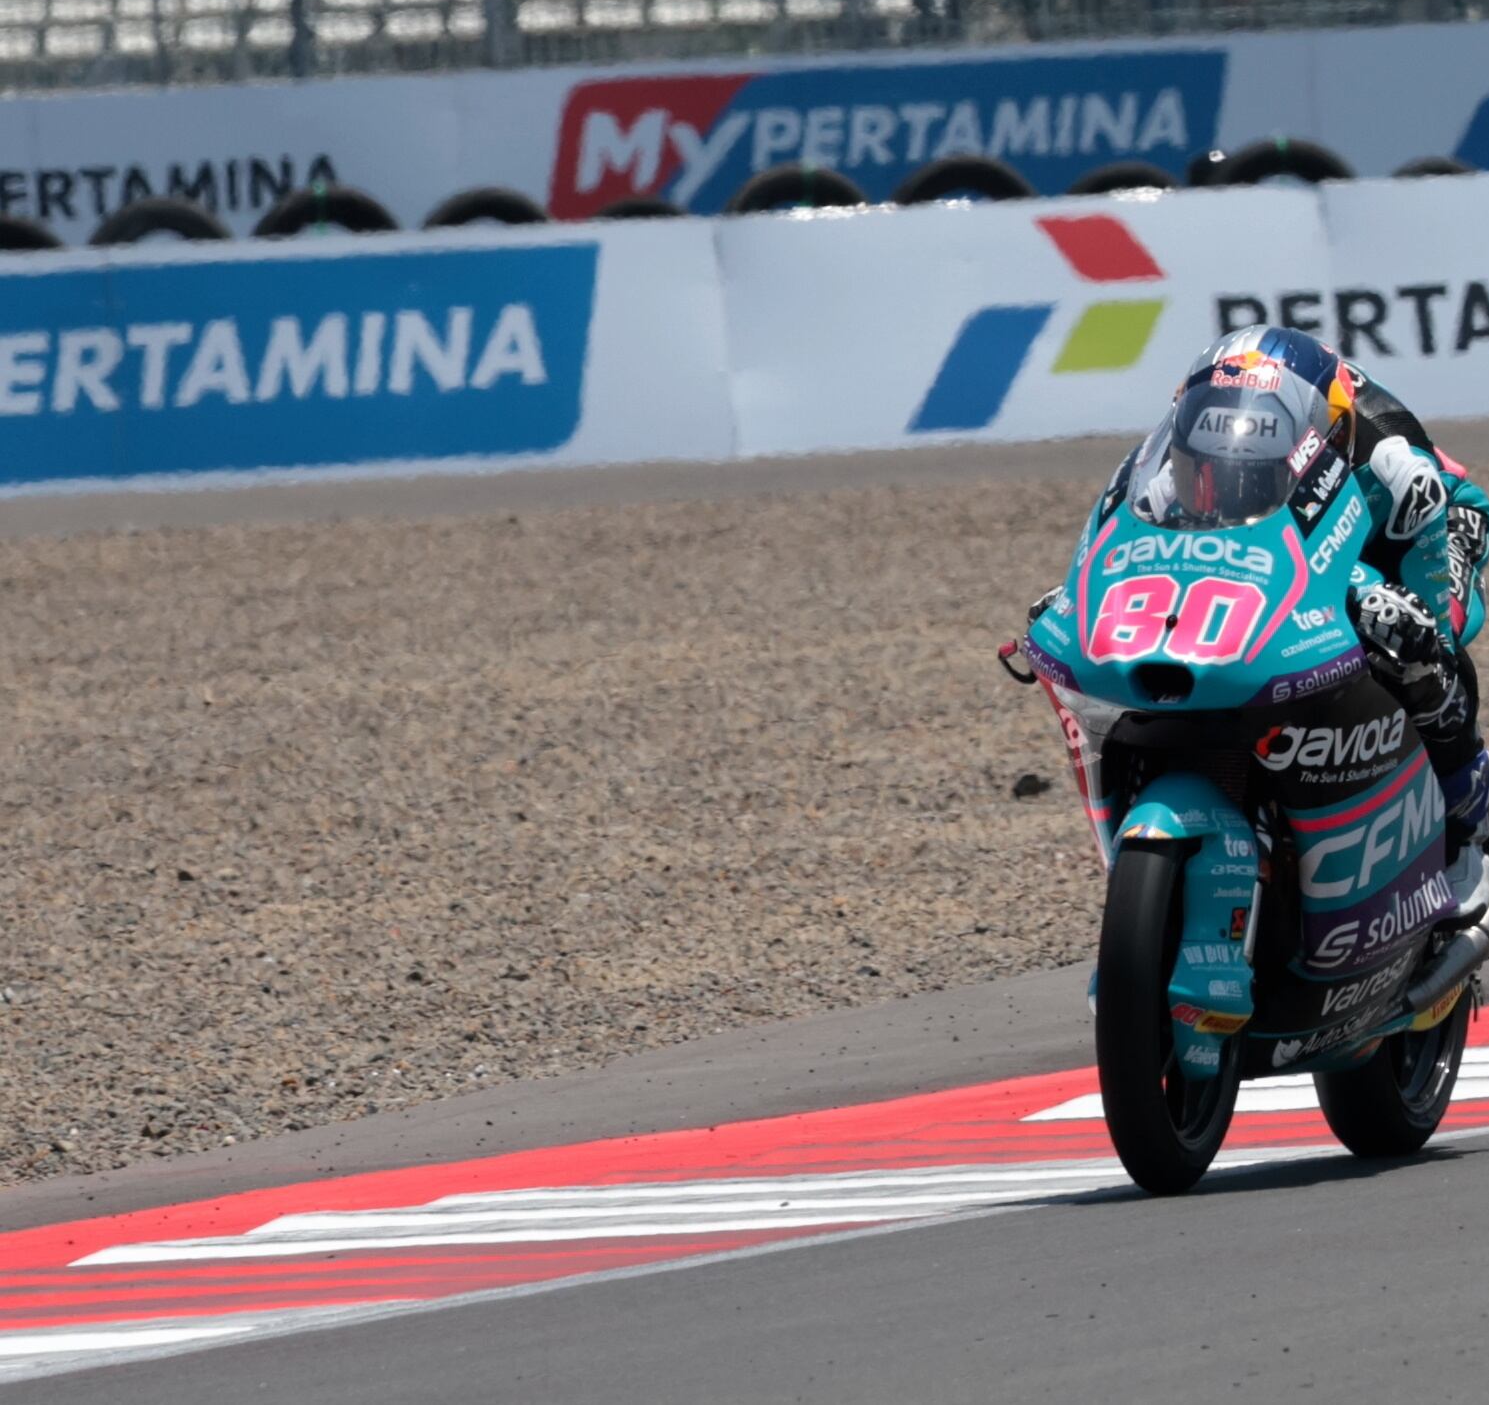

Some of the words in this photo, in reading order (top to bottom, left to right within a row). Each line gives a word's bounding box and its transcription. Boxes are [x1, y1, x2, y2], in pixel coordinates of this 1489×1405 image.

[1211, 368, 1243, 388] Red
[1246, 373, 1281, 391] Bull
[1198, 412, 1278, 438] AIROH
[1308, 497, 1363, 575] CFMOTO
[1102, 534, 1273, 576] gaviota
[1154, 562, 1171, 572] Sun
[1172, 563, 1180, 572] &
[1182, 562, 1216, 574] Shutter
[1087, 574, 1266, 666] 80
[1291, 606, 1336, 632] trex
[1296, 656, 1362, 693] solunion
[1252, 707, 1406, 772] gaviota
[1299, 771, 1319, 783] The
[1320, 769, 1337, 784] Sun
[1363, 870, 1453, 950] solunion
